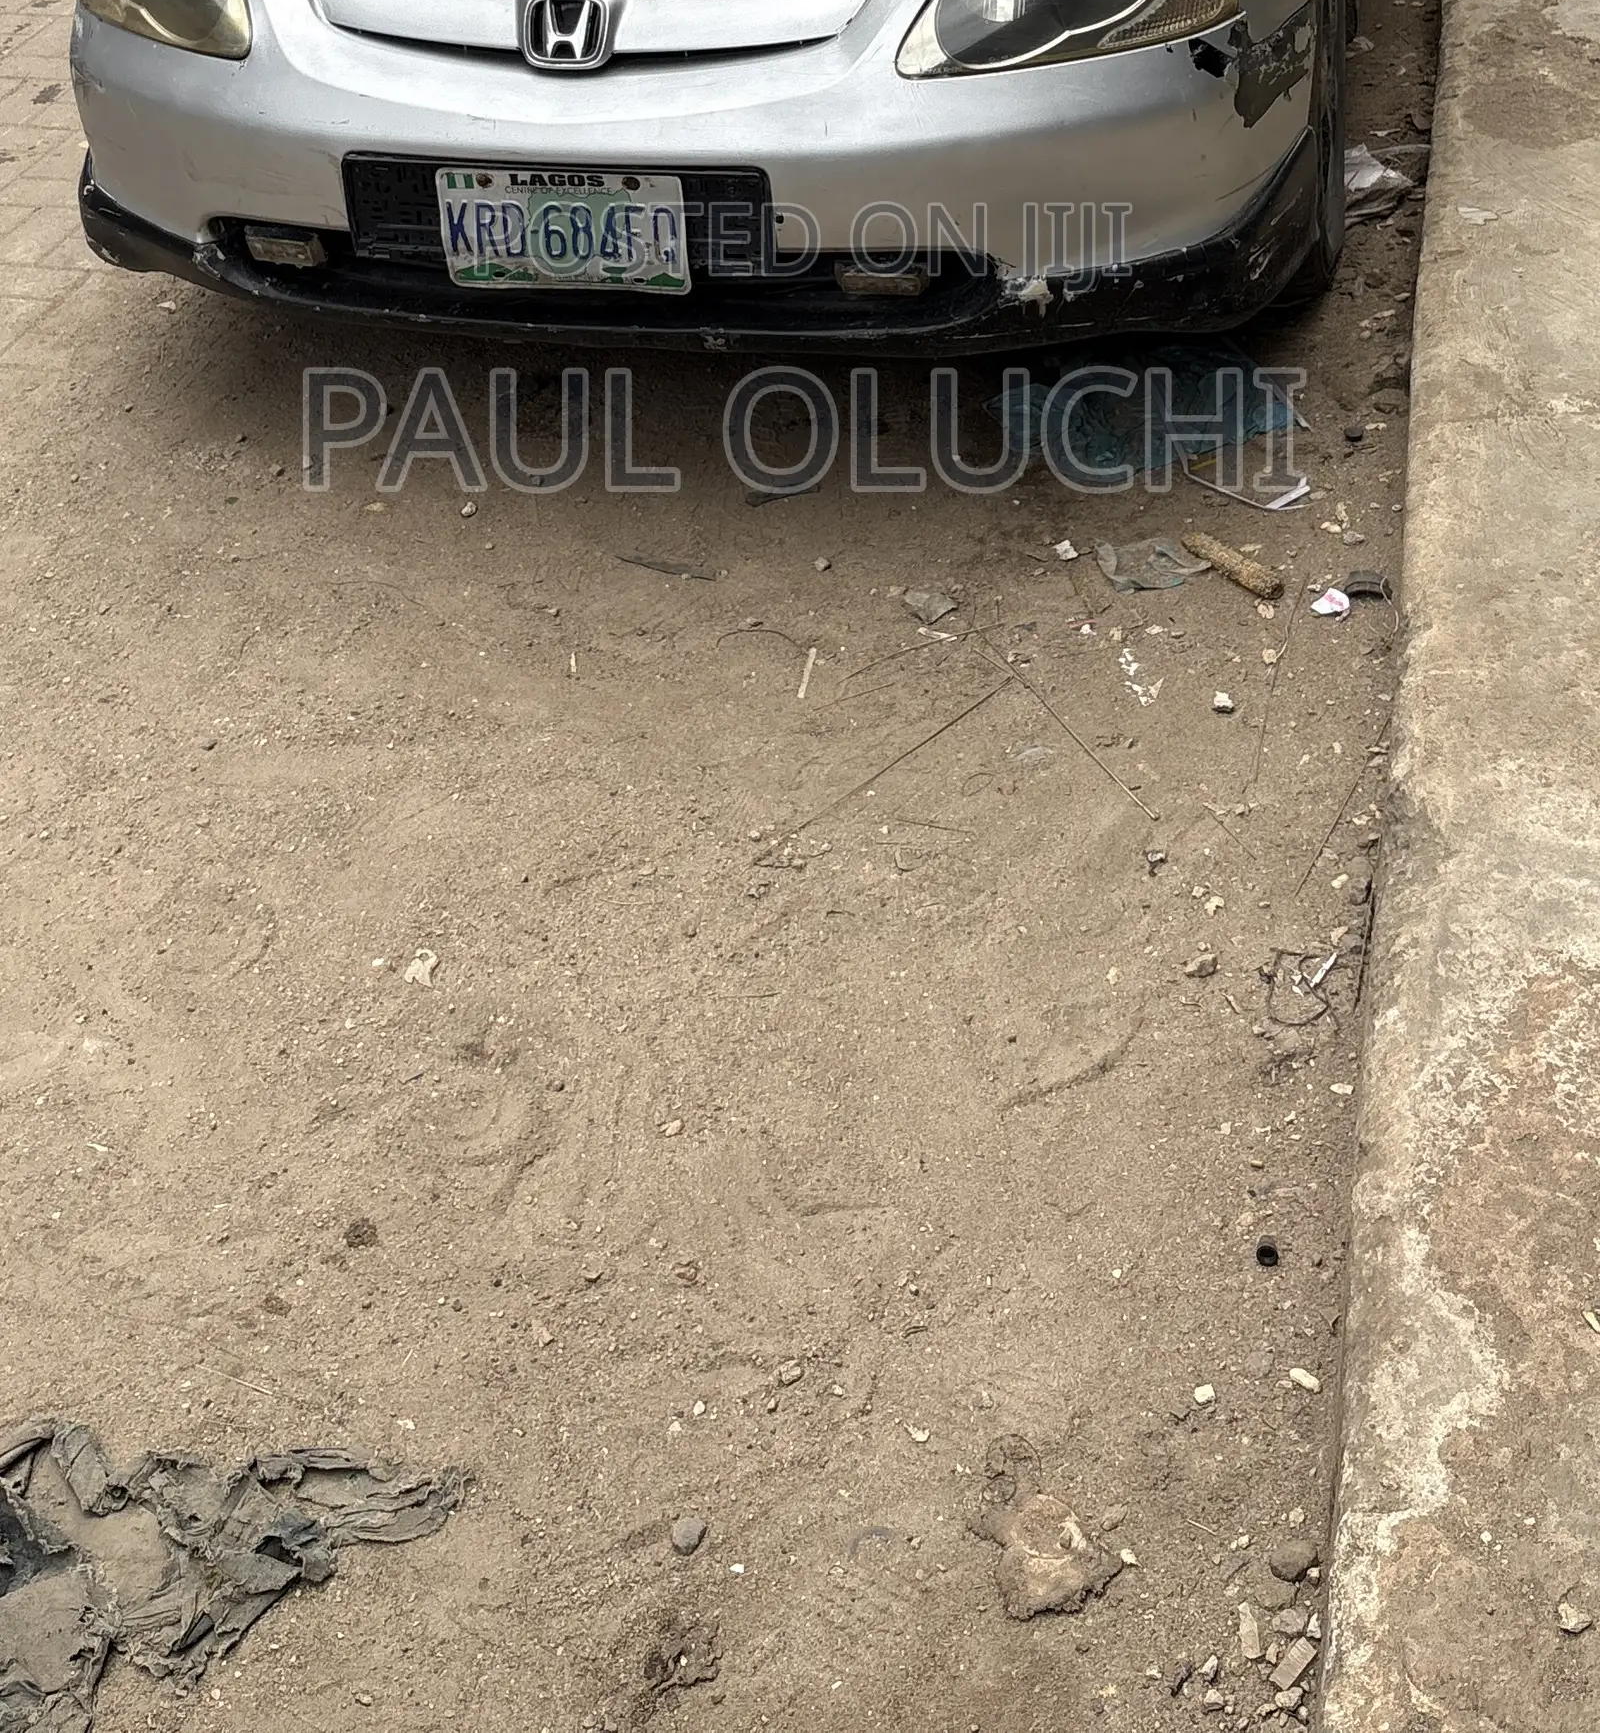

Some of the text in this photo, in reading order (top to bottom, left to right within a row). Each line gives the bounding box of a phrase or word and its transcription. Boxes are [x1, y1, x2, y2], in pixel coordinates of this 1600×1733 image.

[508, 173, 605, 187] LAGOS
[504, 185, 613, 196] CENTRE OF EXCELLENCE
